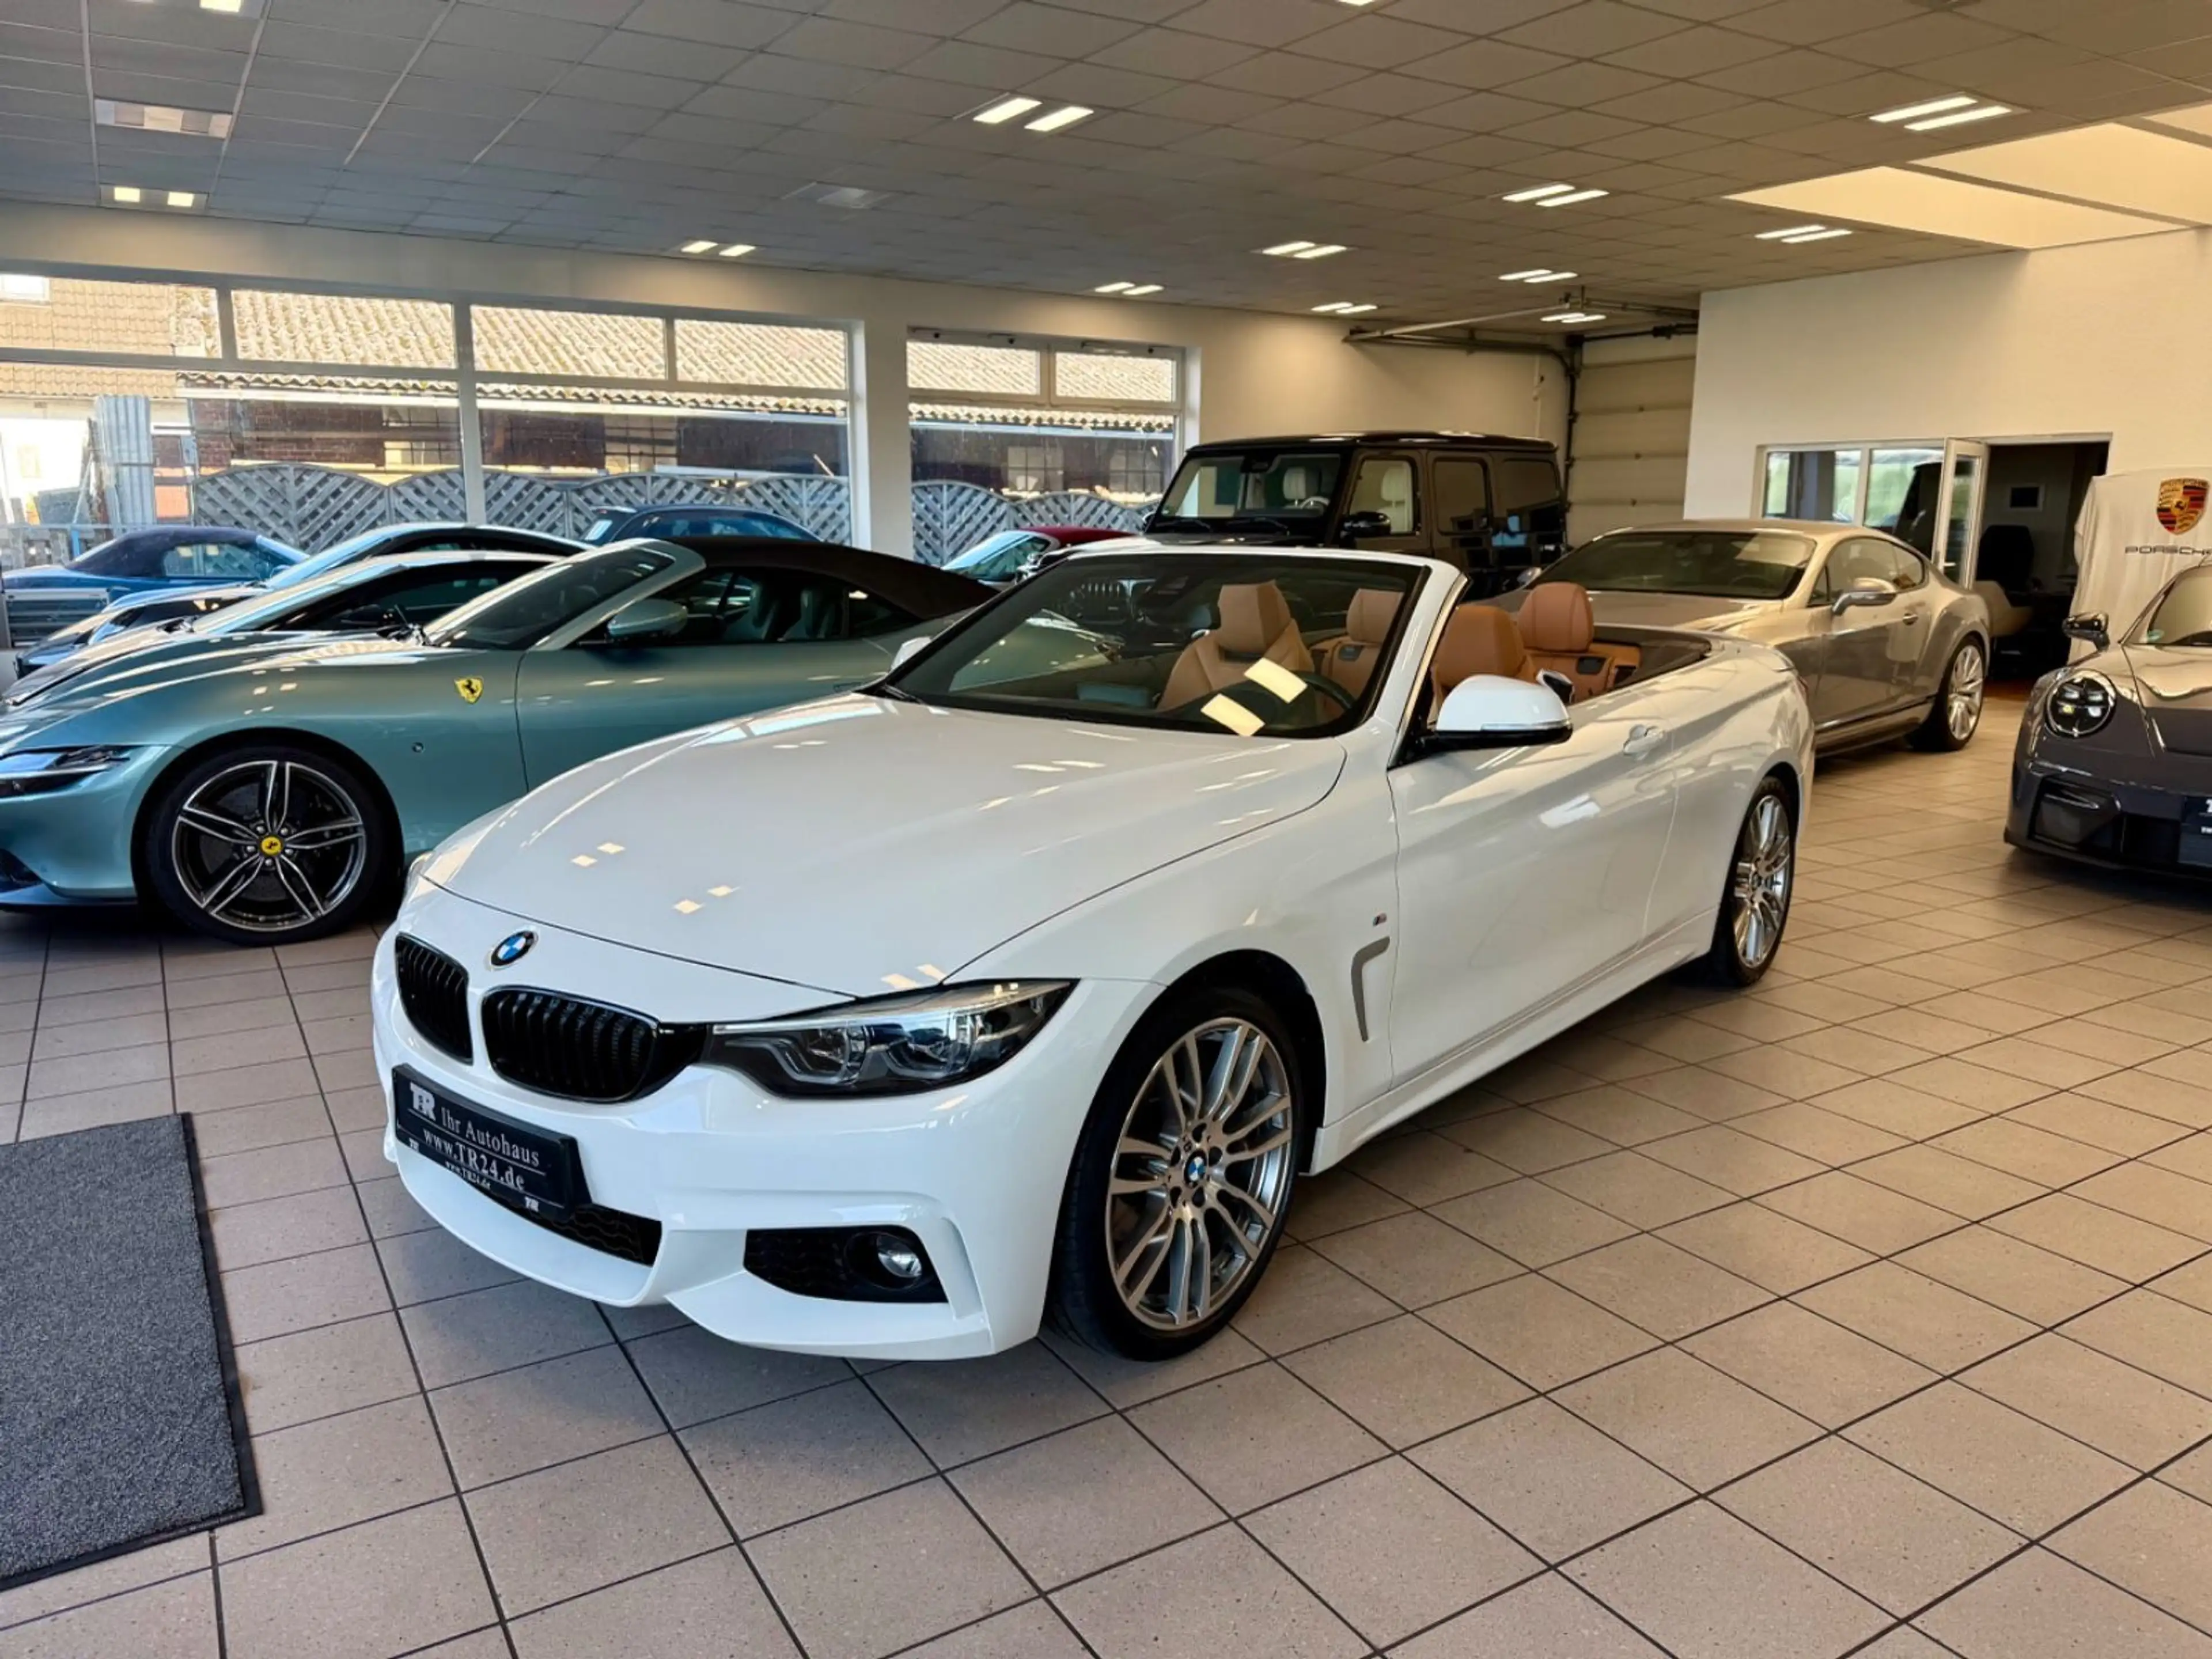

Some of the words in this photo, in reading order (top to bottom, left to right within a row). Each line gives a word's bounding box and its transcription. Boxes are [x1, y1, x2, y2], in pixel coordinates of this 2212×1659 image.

[423, 1128, 525, 1192] www.TR24.de
[441, 1107, 461, 1134] Ihr
[465, 1120, 540, 1167] Autohaus
